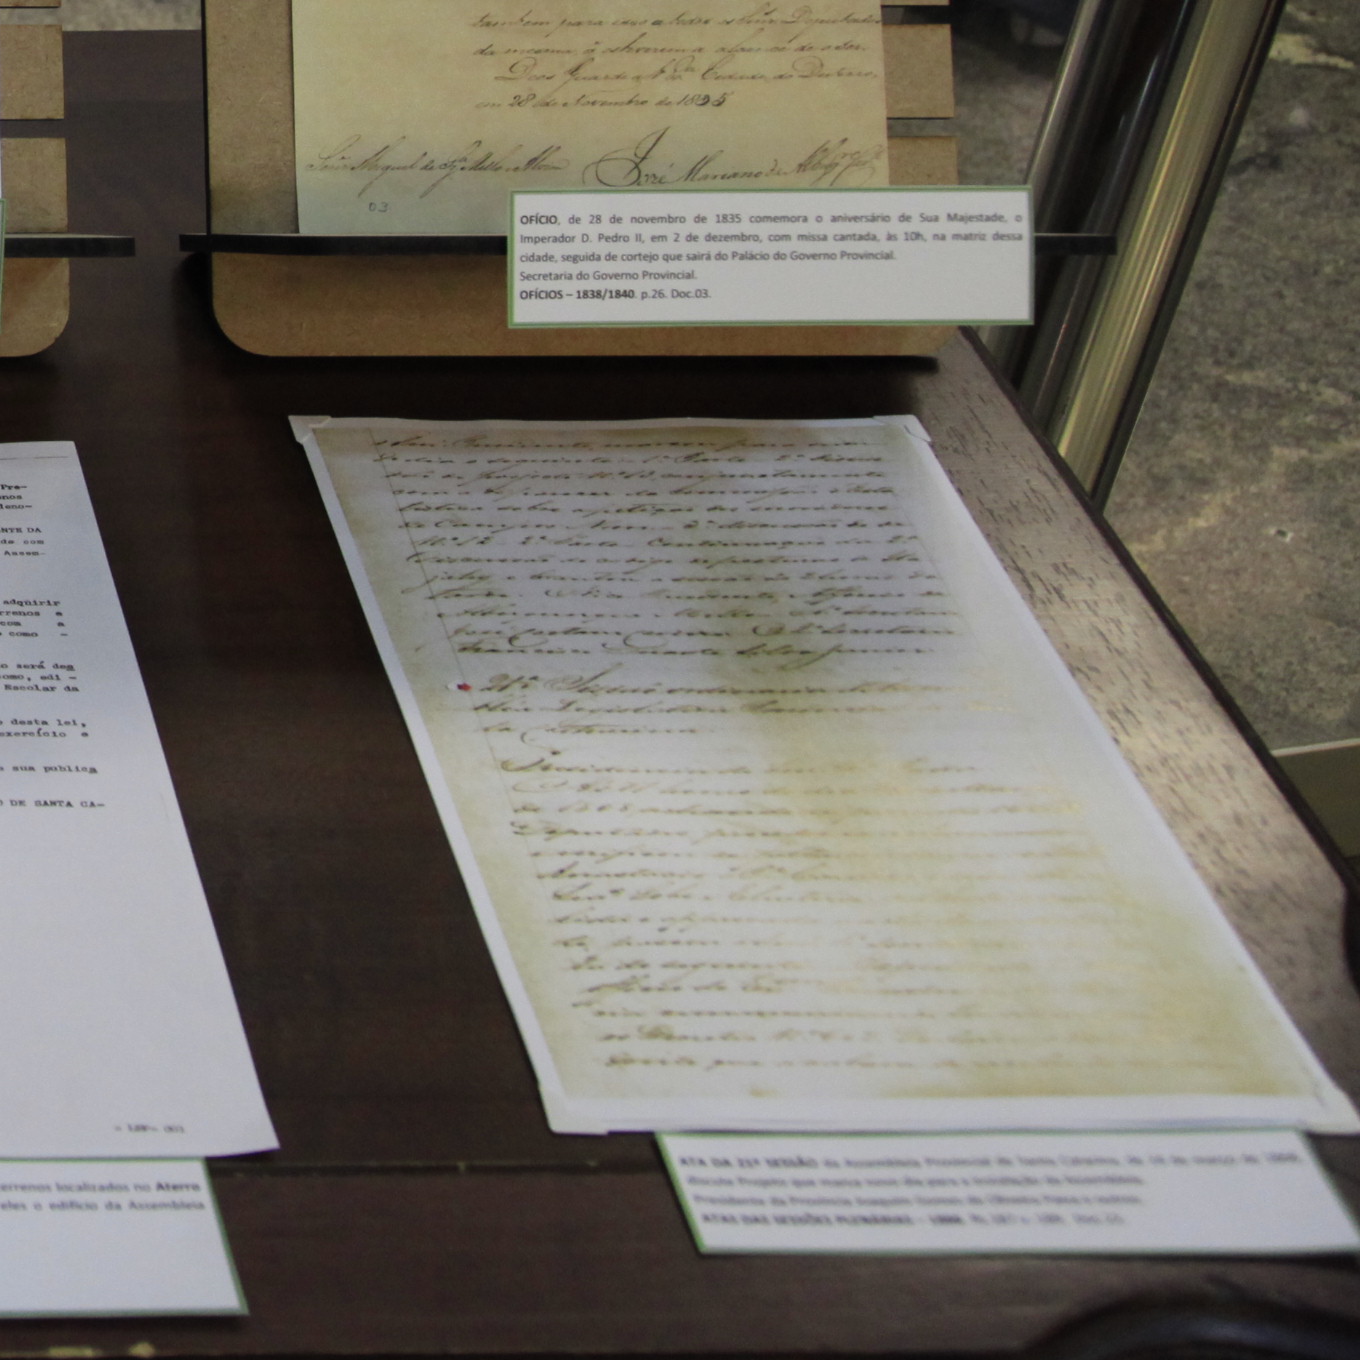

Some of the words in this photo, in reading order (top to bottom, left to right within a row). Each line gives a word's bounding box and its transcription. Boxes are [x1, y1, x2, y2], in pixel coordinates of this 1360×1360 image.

[520, 271, 573, 282] Secretaria
[575, 270, 590, 281] do
[592, 270, 639, 281] Governo
